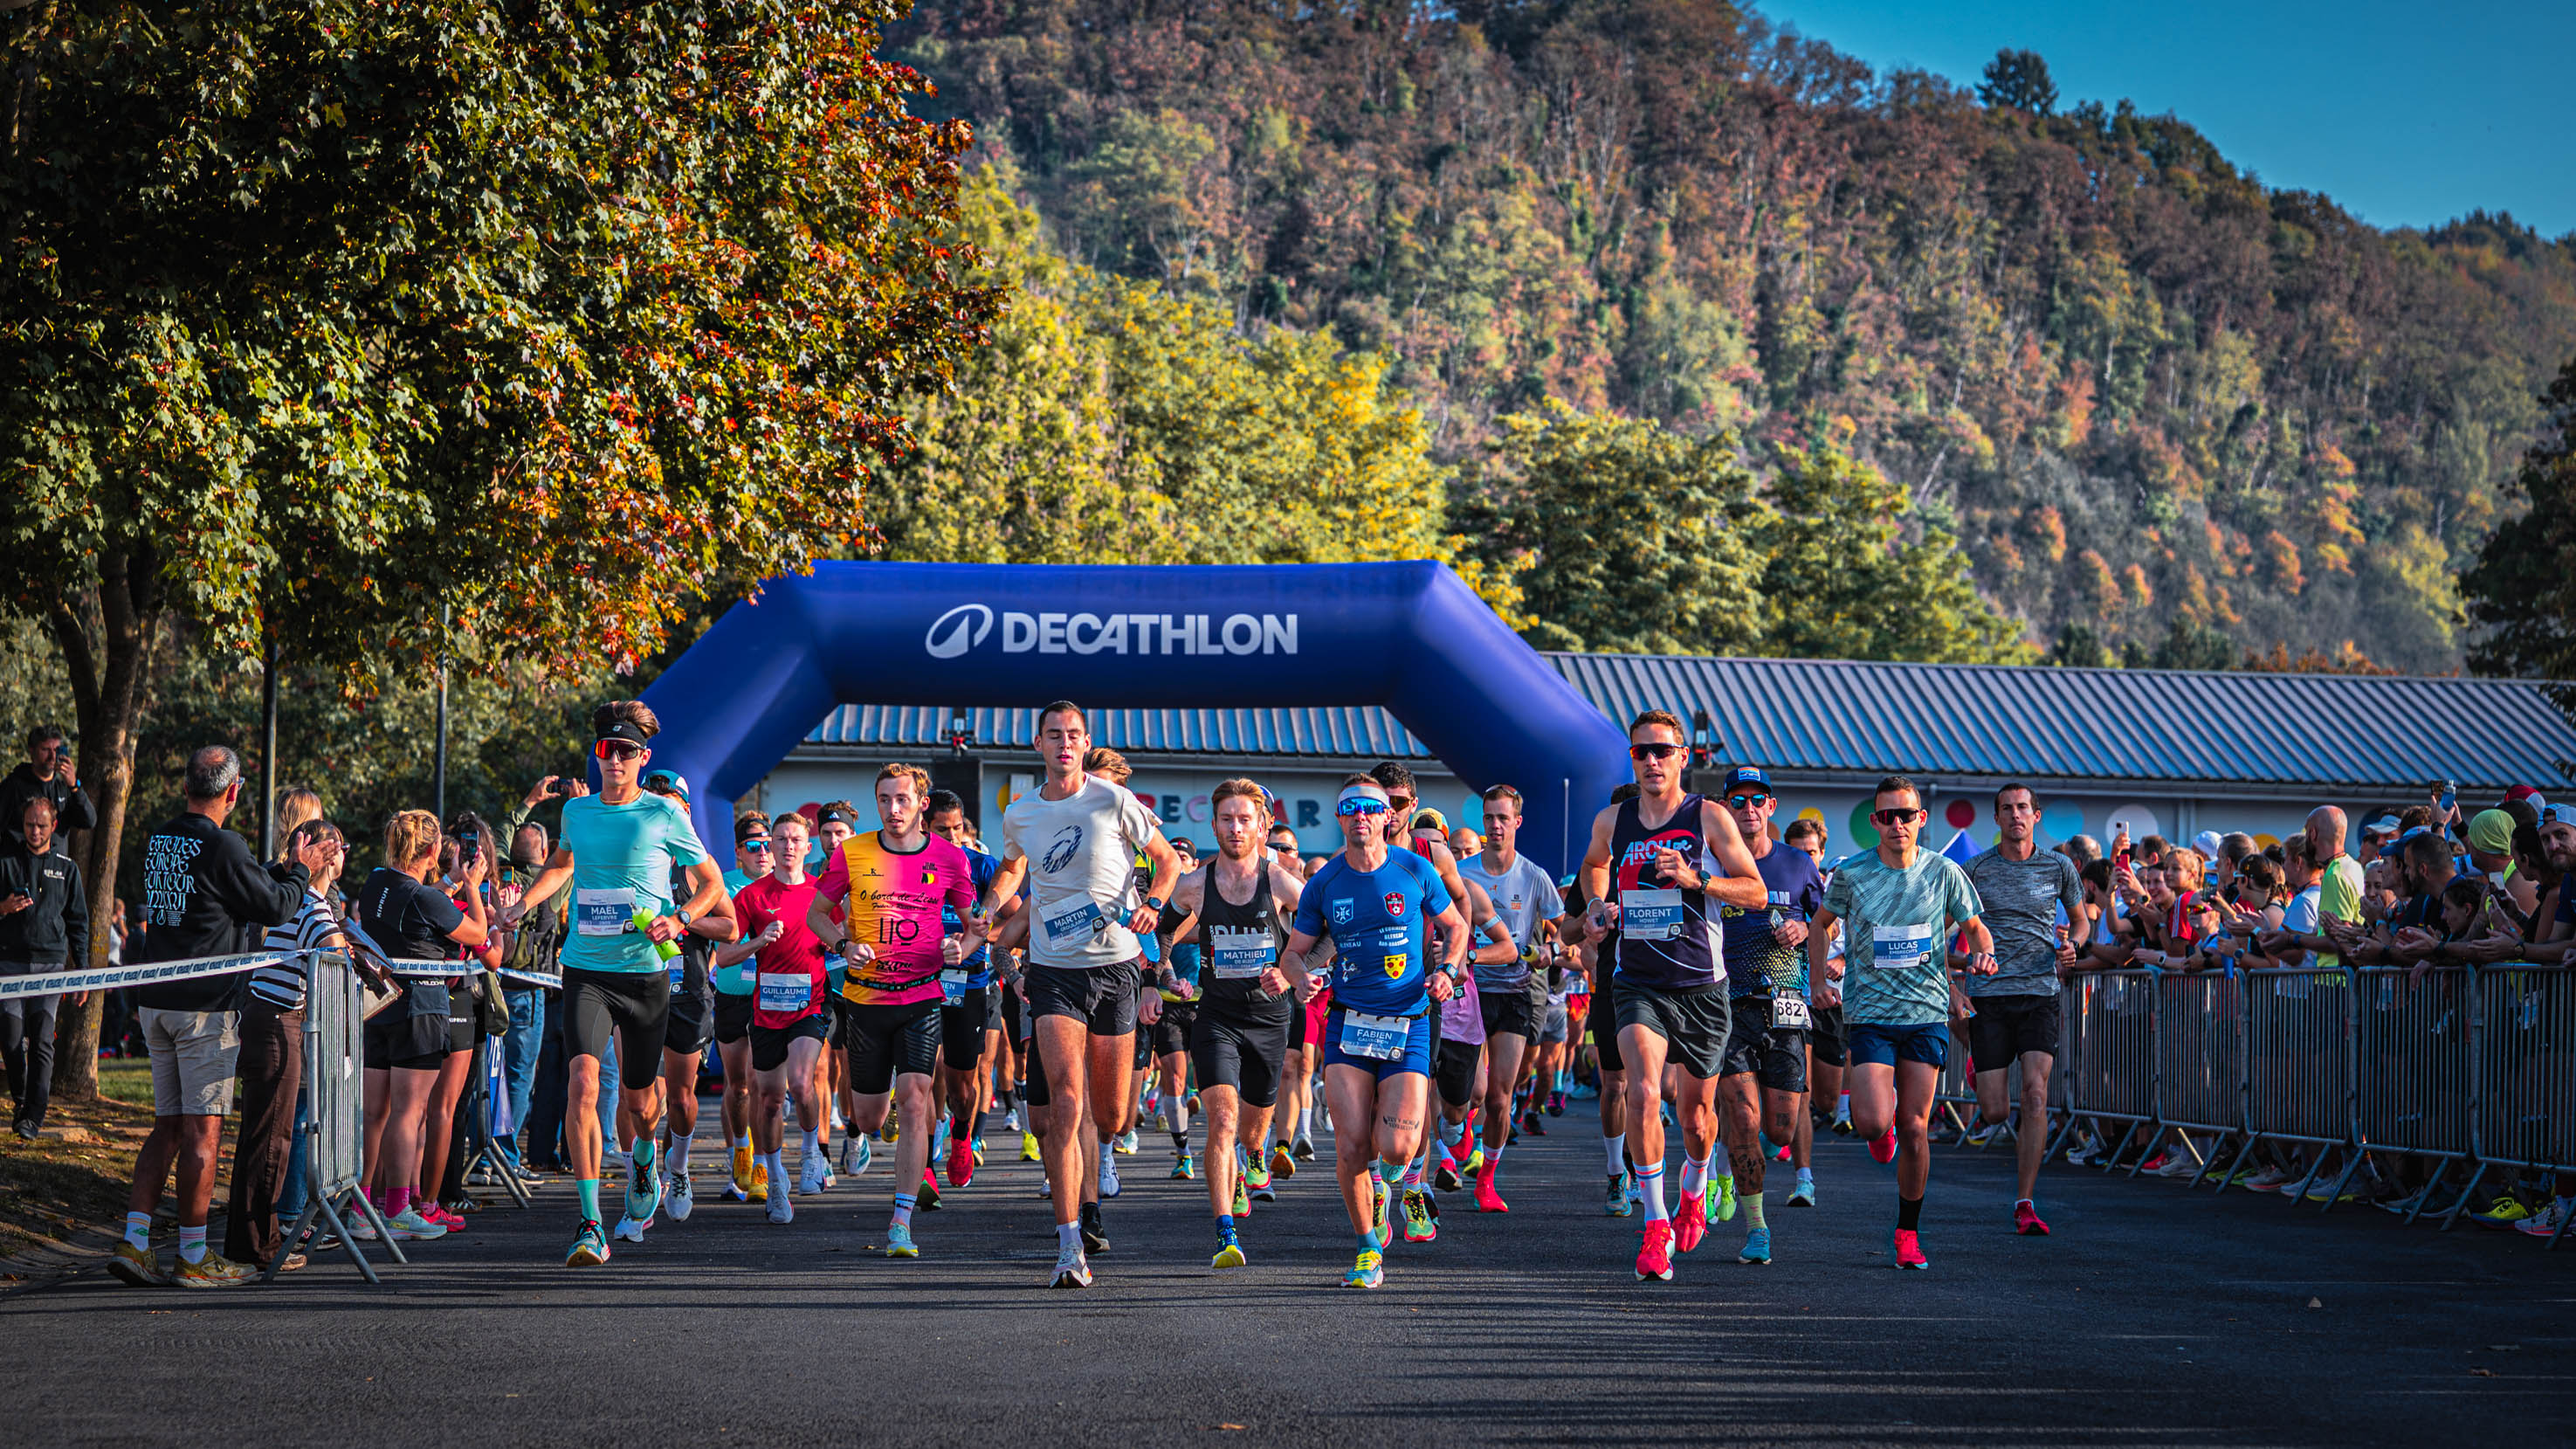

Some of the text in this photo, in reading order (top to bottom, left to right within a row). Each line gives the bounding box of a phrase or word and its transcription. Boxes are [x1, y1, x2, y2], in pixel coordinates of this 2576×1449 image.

[1002, 612, 1298, 655] DECATHLON
[149, 834, 203, 857] EFTONES
[376, 887, 389, 918] KIPRUN
[1054, 909, 1088, 928] MARTIN
[1629, 908, 1672, 918] FLORENT
[1888, 941, 1918, 950] LUCAS
[1223, 949, 1267, 960] MATHIEU
[1357, 1029, 1393, 1040] FABIEN
